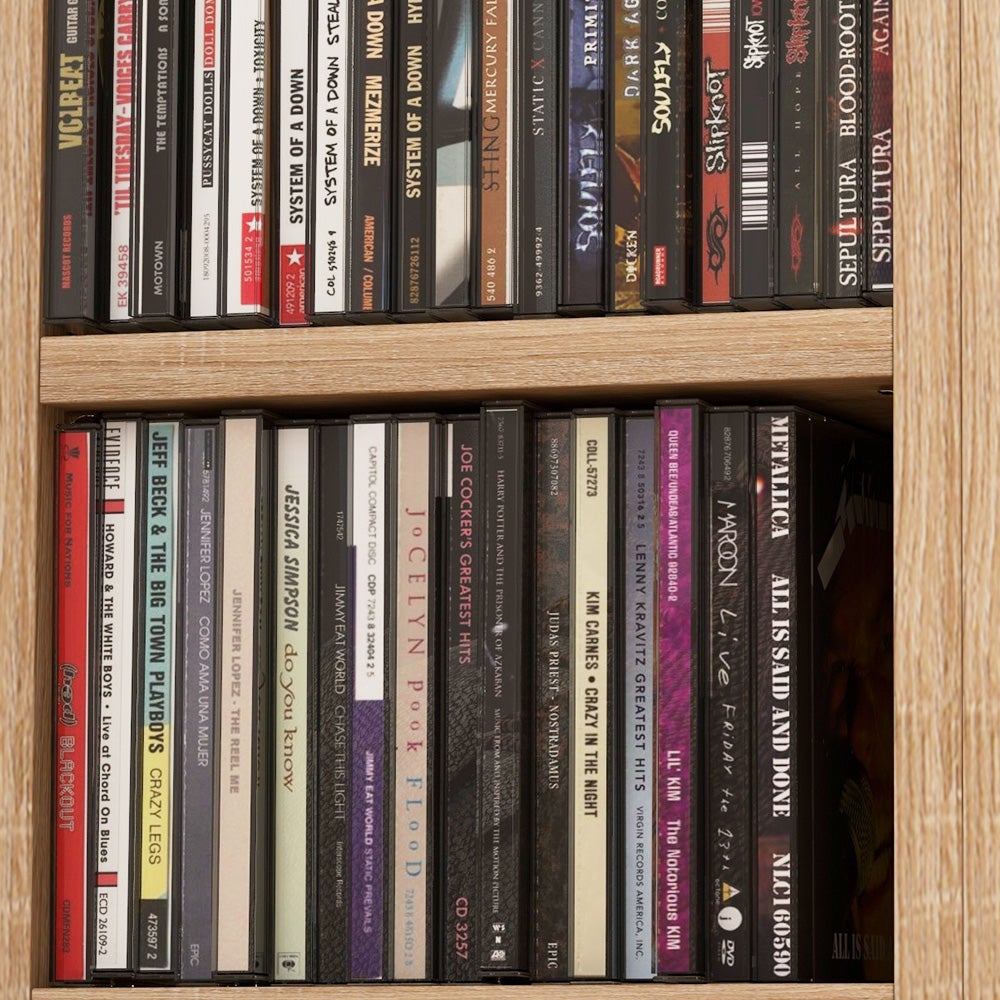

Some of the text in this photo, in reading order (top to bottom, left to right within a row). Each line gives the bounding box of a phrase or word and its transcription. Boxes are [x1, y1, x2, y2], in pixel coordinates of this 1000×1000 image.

[156, 47, 167, 151] THE TEMPTATIONS
[406, 46, 422, 198] SYSTEM OF A DOWN
[532, 59, 544, 135] STATIC X
[652, 42, 671, 133] SOULFLY
[203, 72, 213, 185] PUSSYCAT DOLLS
[290, 69, 304, 224] SYSTEM OF A DOWN
[839, 159, 857, 285] SEPULTURA
[873, 128, 891, 262] SEPULTURA
[117, 245, 129, 307] EK 39458
[154, 241, 164, 295] MOTOWN
[535, 227, 543, 296] 9362-49992-4
[104, 524, 114, 579] HOWARD
[284, 485, 299, 631] JESSICA SIMPSON
[459, 445, 472, 664] JOE COCKER'S GREATEST HITS
[103, 623, 113, 662] WHITE
[104, 597, 114, 619] THE
[771, 416, 790, 817] METALLICA ALL IS SAID AND DONE
[103, 666, 112, 697] BOYS
[148, 432, 167, 865] JEFF BECK & THE BIG TOWN PLAYBOYS CRAZY LEGS
[102, 716, 111, 740] Live
[102, 746, 110, 758] at
[60, 736, 74, 831] BLACKOUT
[101, 763, 111, 801] Chord
[101, 807, 110, 824] On
[100, 829, 110, 863] Blues
[98, 893, 107, 955] ECD 26109-2
[147, 913, 157, 949] 473597
[772, 853, 791, 977] NLC160590
